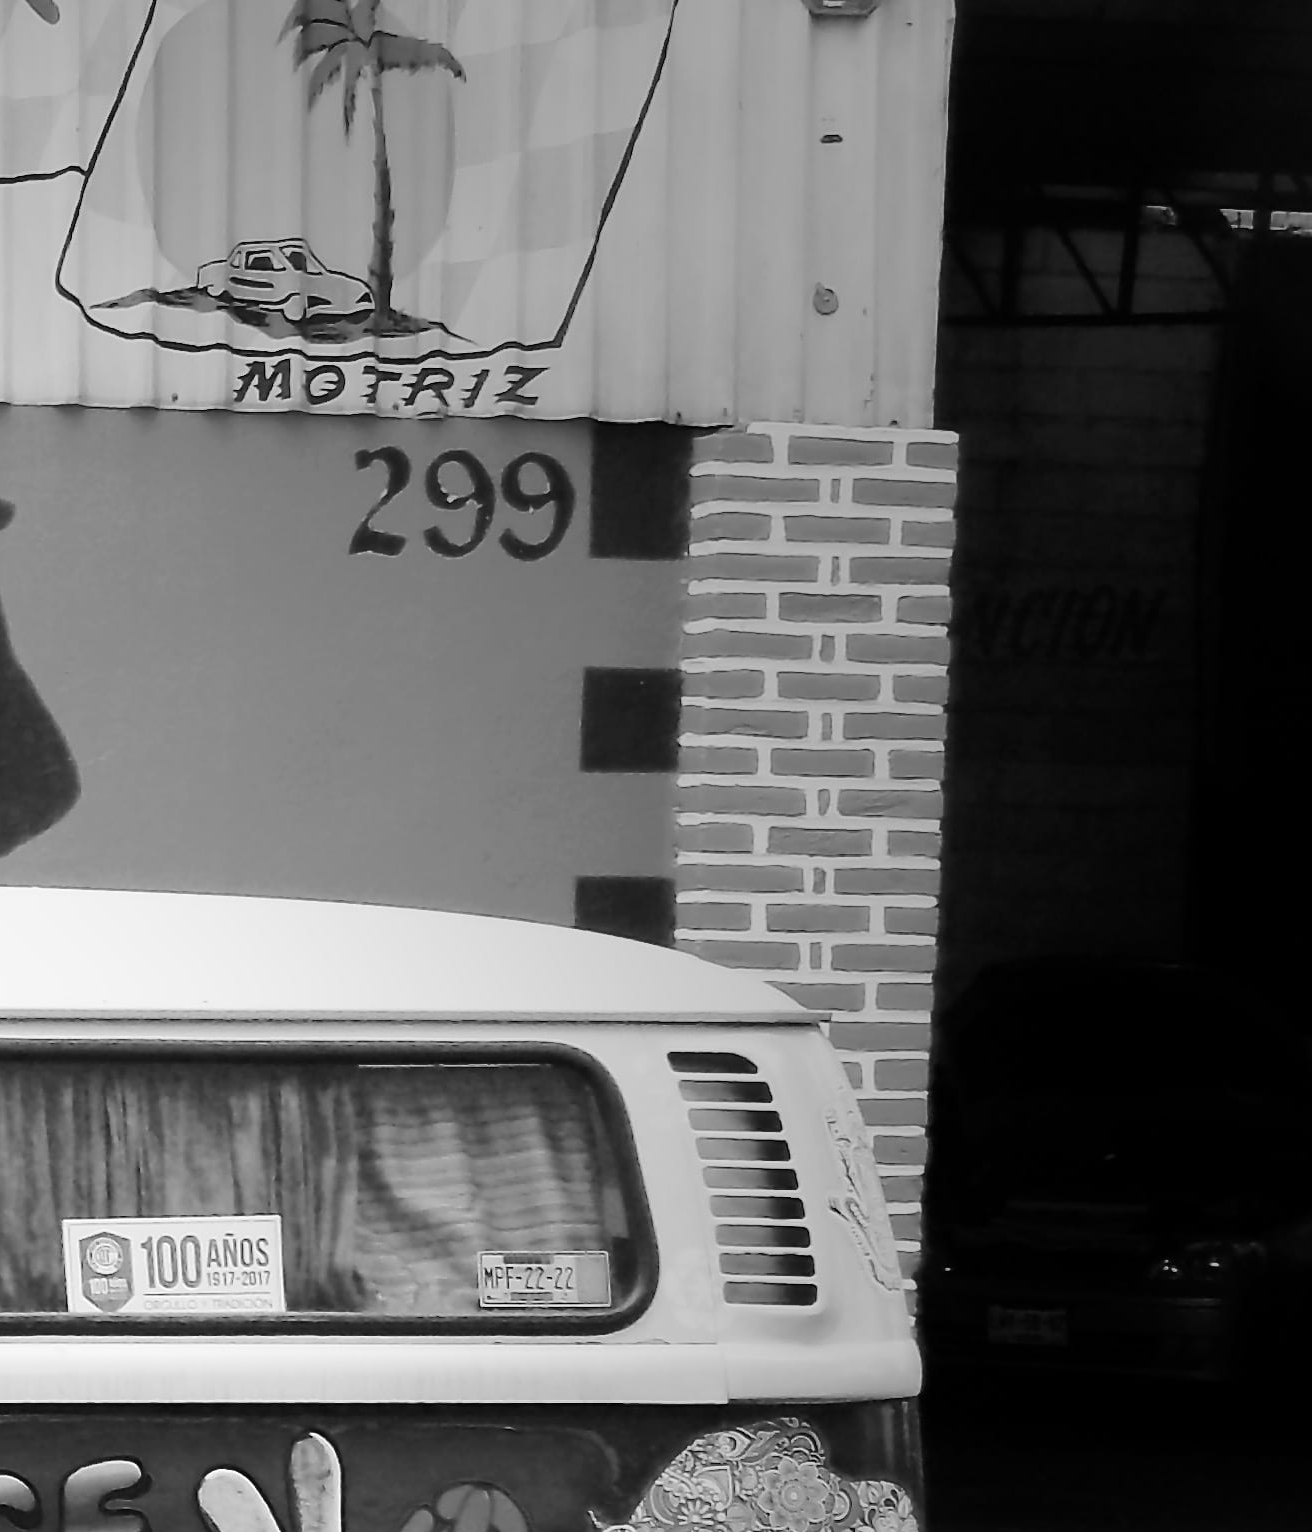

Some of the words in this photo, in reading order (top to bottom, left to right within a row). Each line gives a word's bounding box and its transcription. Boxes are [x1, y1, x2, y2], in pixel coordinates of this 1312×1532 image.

[231, 359, 550, 408] MOTRIZ
[348, 444, 574, 562] 299
[140, 1234, 202, 1290] 100
[206, 1233, 270, 1269] AÑOS
[206, 1269, 271, 1287] 1917-2017
